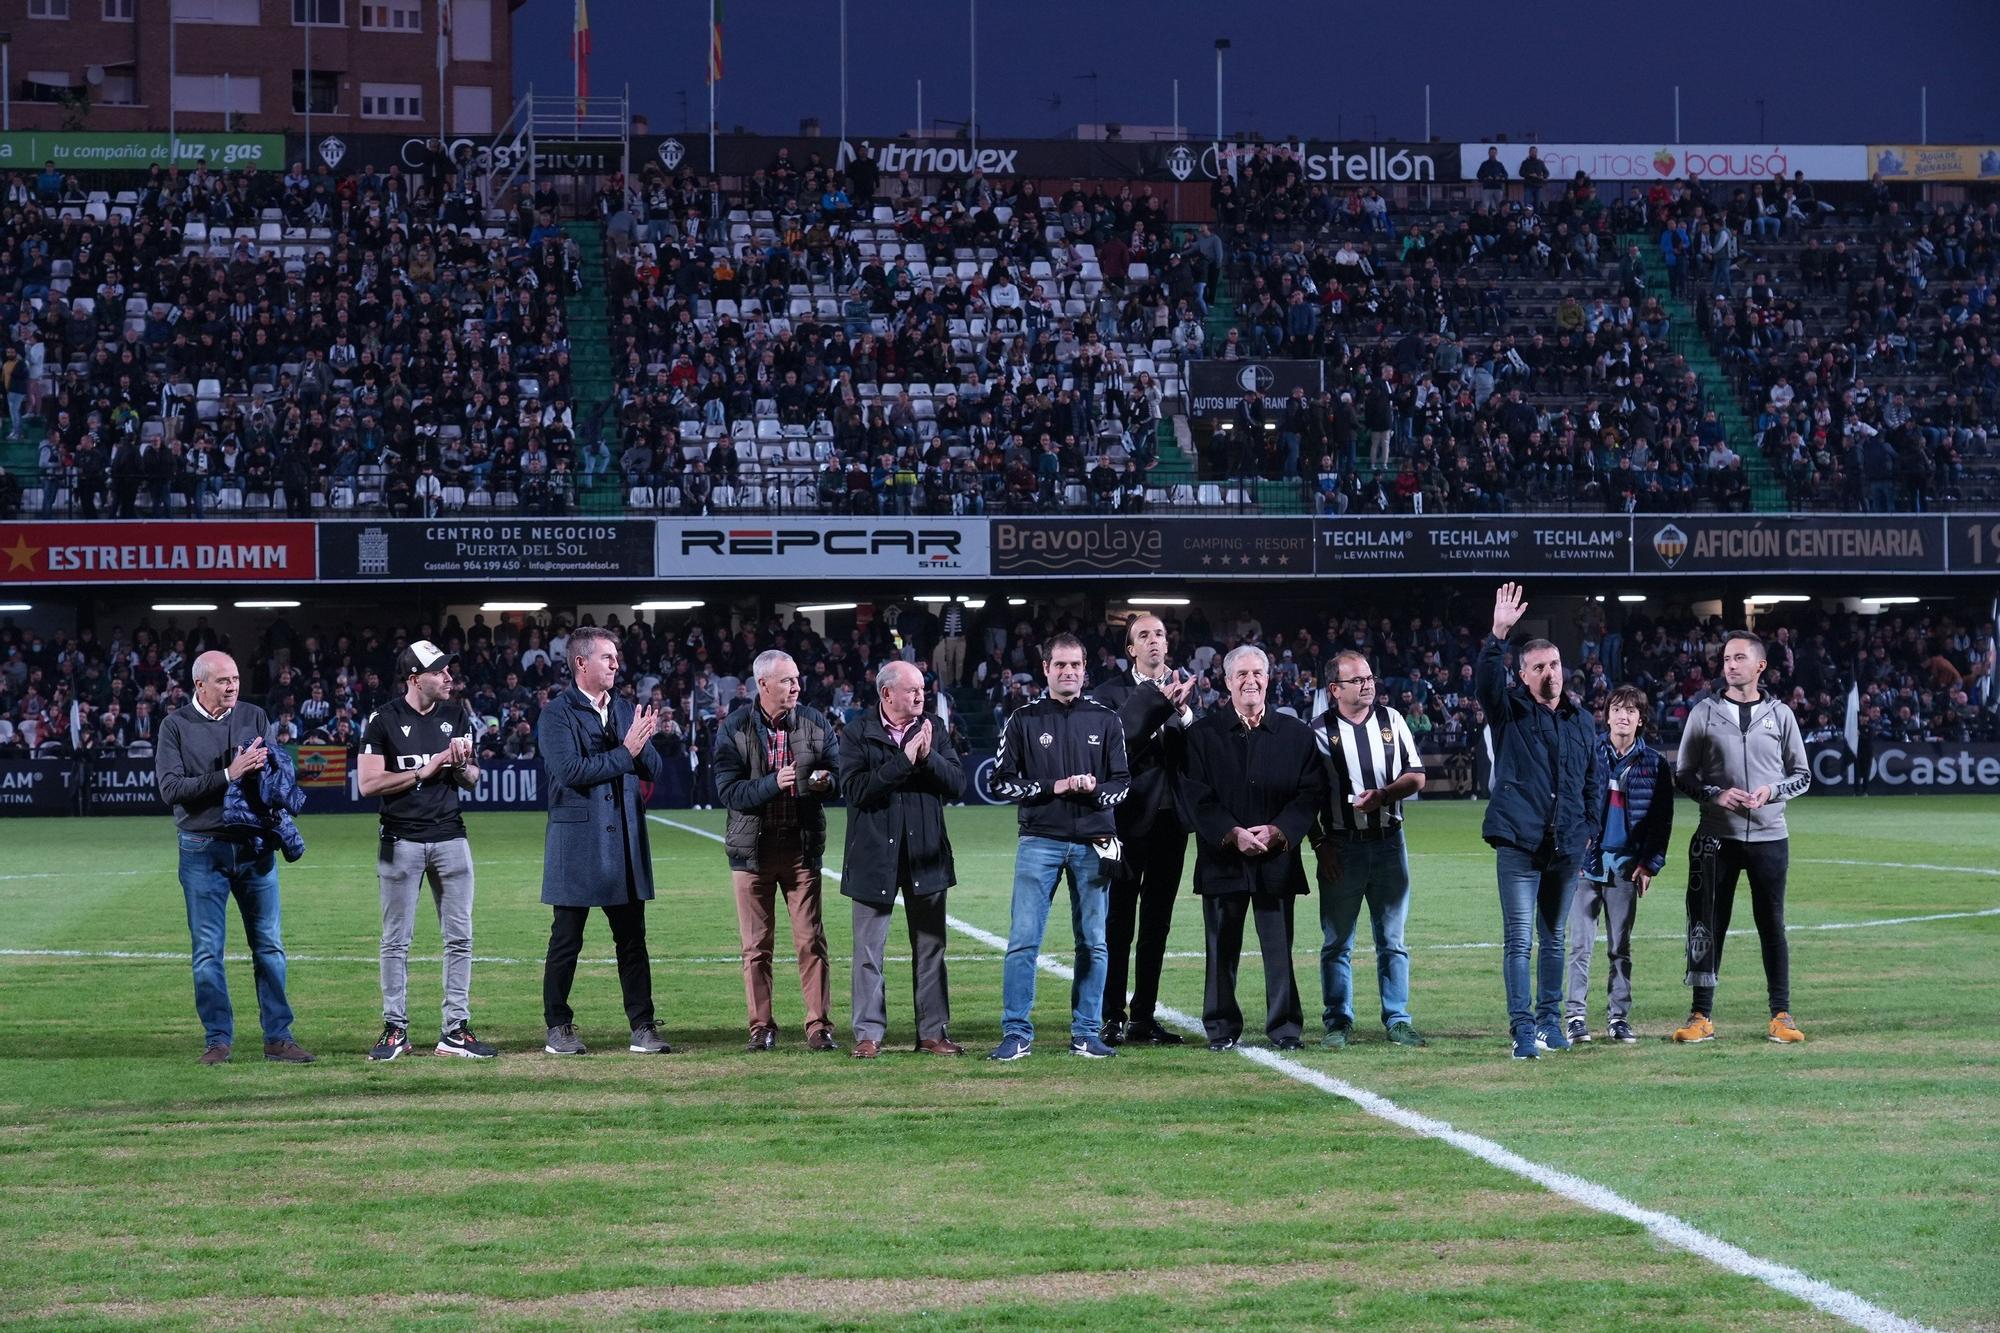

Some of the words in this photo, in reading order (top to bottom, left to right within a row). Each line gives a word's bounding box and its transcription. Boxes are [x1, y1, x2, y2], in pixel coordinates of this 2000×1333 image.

[54, 144, 69, 158] tu
[73, 143, 146, 161] compañía
[150, 144, 168, 158] de
[172, 139, 206, 159] luz
[210, 147, 220, 160] y
[223, 144, 262, 163] gas
[1543, 152, 1649, 177] frutas
[1685, 147, 1788, 177] bausá
[1193, 398, 1224, 409] AUTOS
[426, 528, 494, 540] CENTRO
[501, 527, 521, 539] DE
[532, 527, 617, 539] NEGOCIOS
[998, 523, 1162, 557] Bravoplaya
[1693, 522, 1780, 557] AFICIÓN
[1785, 529, 1924, 557] CENTENARIA
[556, 542, 588, 556] SOL
[682, 530, 962, 555] REPCAR
[1183, 538, 1243, 549] CAMPING
[1255, 537, 1306, 549] RESORT
[48, 545, 190, 571] ESTRELLA
[196, 544, 288, 569] DAMM
[1343, 551, 1405, 560] LEVANTINA
[1450, 550, 1511, 559] LEVANTINA
[1554, 550, 1615, 559] LEVANTINA
[424, 562, 461, 570] Castellón
[463, 561, 481, 571] 964
[483, 561, 501, 571] 199
[502, 560, 520, 570] 450
[91, 793, 155, 803] EVANTINA
